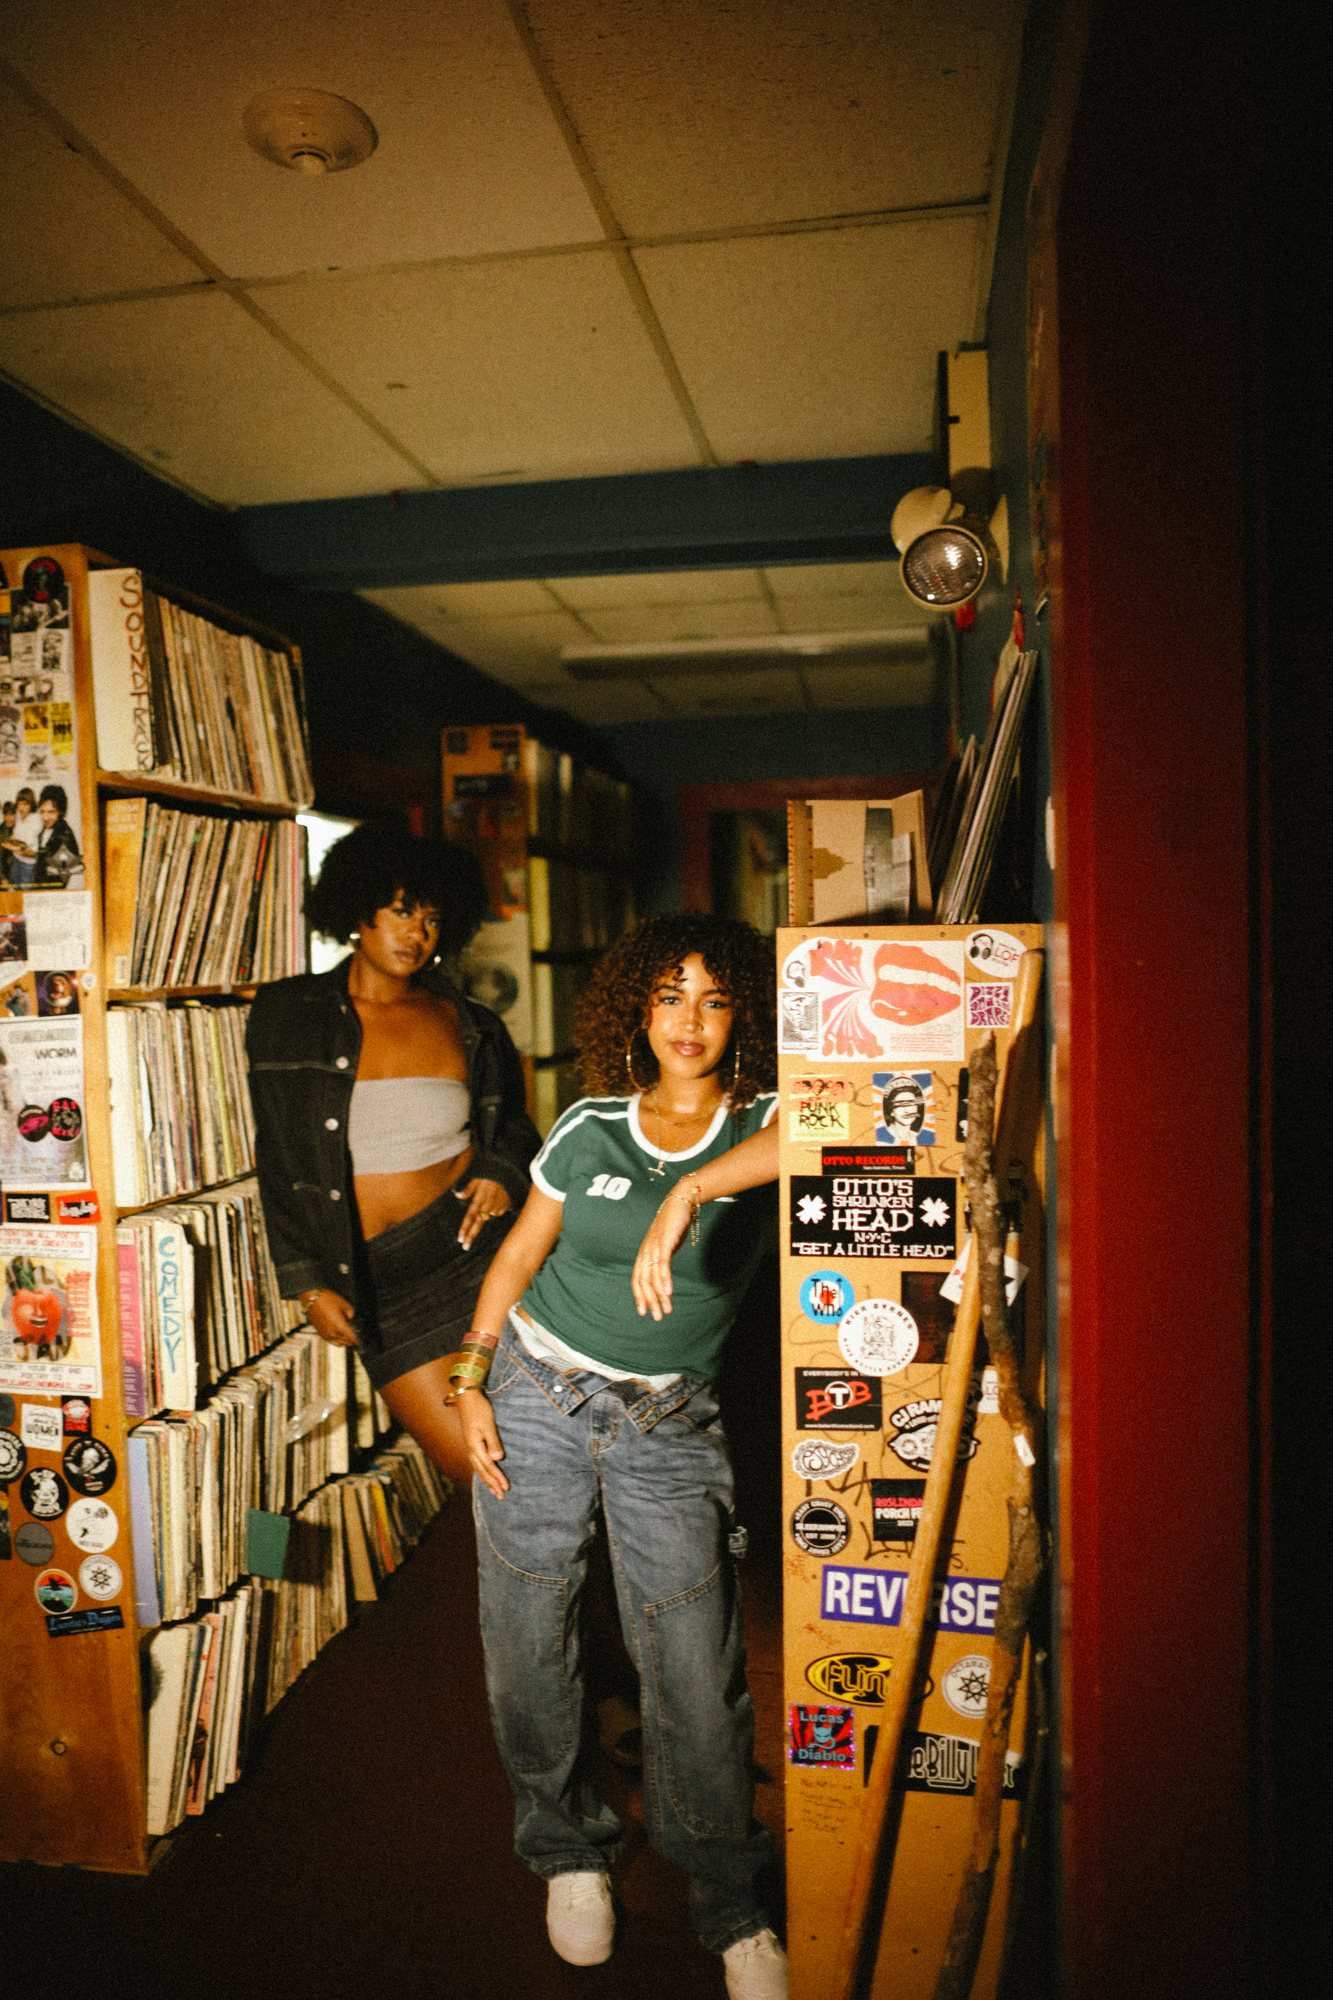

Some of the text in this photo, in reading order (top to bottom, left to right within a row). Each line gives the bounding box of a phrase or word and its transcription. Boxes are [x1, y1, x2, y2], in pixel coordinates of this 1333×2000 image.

[120, 575, 153, 770] SOUNDTRACK
[800, 1101, 839, 1115] PUNK
[799, 1113, 844, 1128] ROCK
[823, 1155, 853, 1166] OTTO
[586, 1173, 632, 1200] 10
[832, 1178, 913, 1196] OTTO'S
[832, 1196, 913, 1208] SHRUNKEN
[832, 1208, 914, 1232] HEAD
[834, 1243, 845, 1255] A
[848, 1244, 900, 1256] LITTLE
[158, 1235, 184, 1373] COMEDY
[825, 1570, 1000, 1628] REVSE
[800, 1711, 845, 1724] Lucas
[798, 1748, 846, 1762] Diablo
